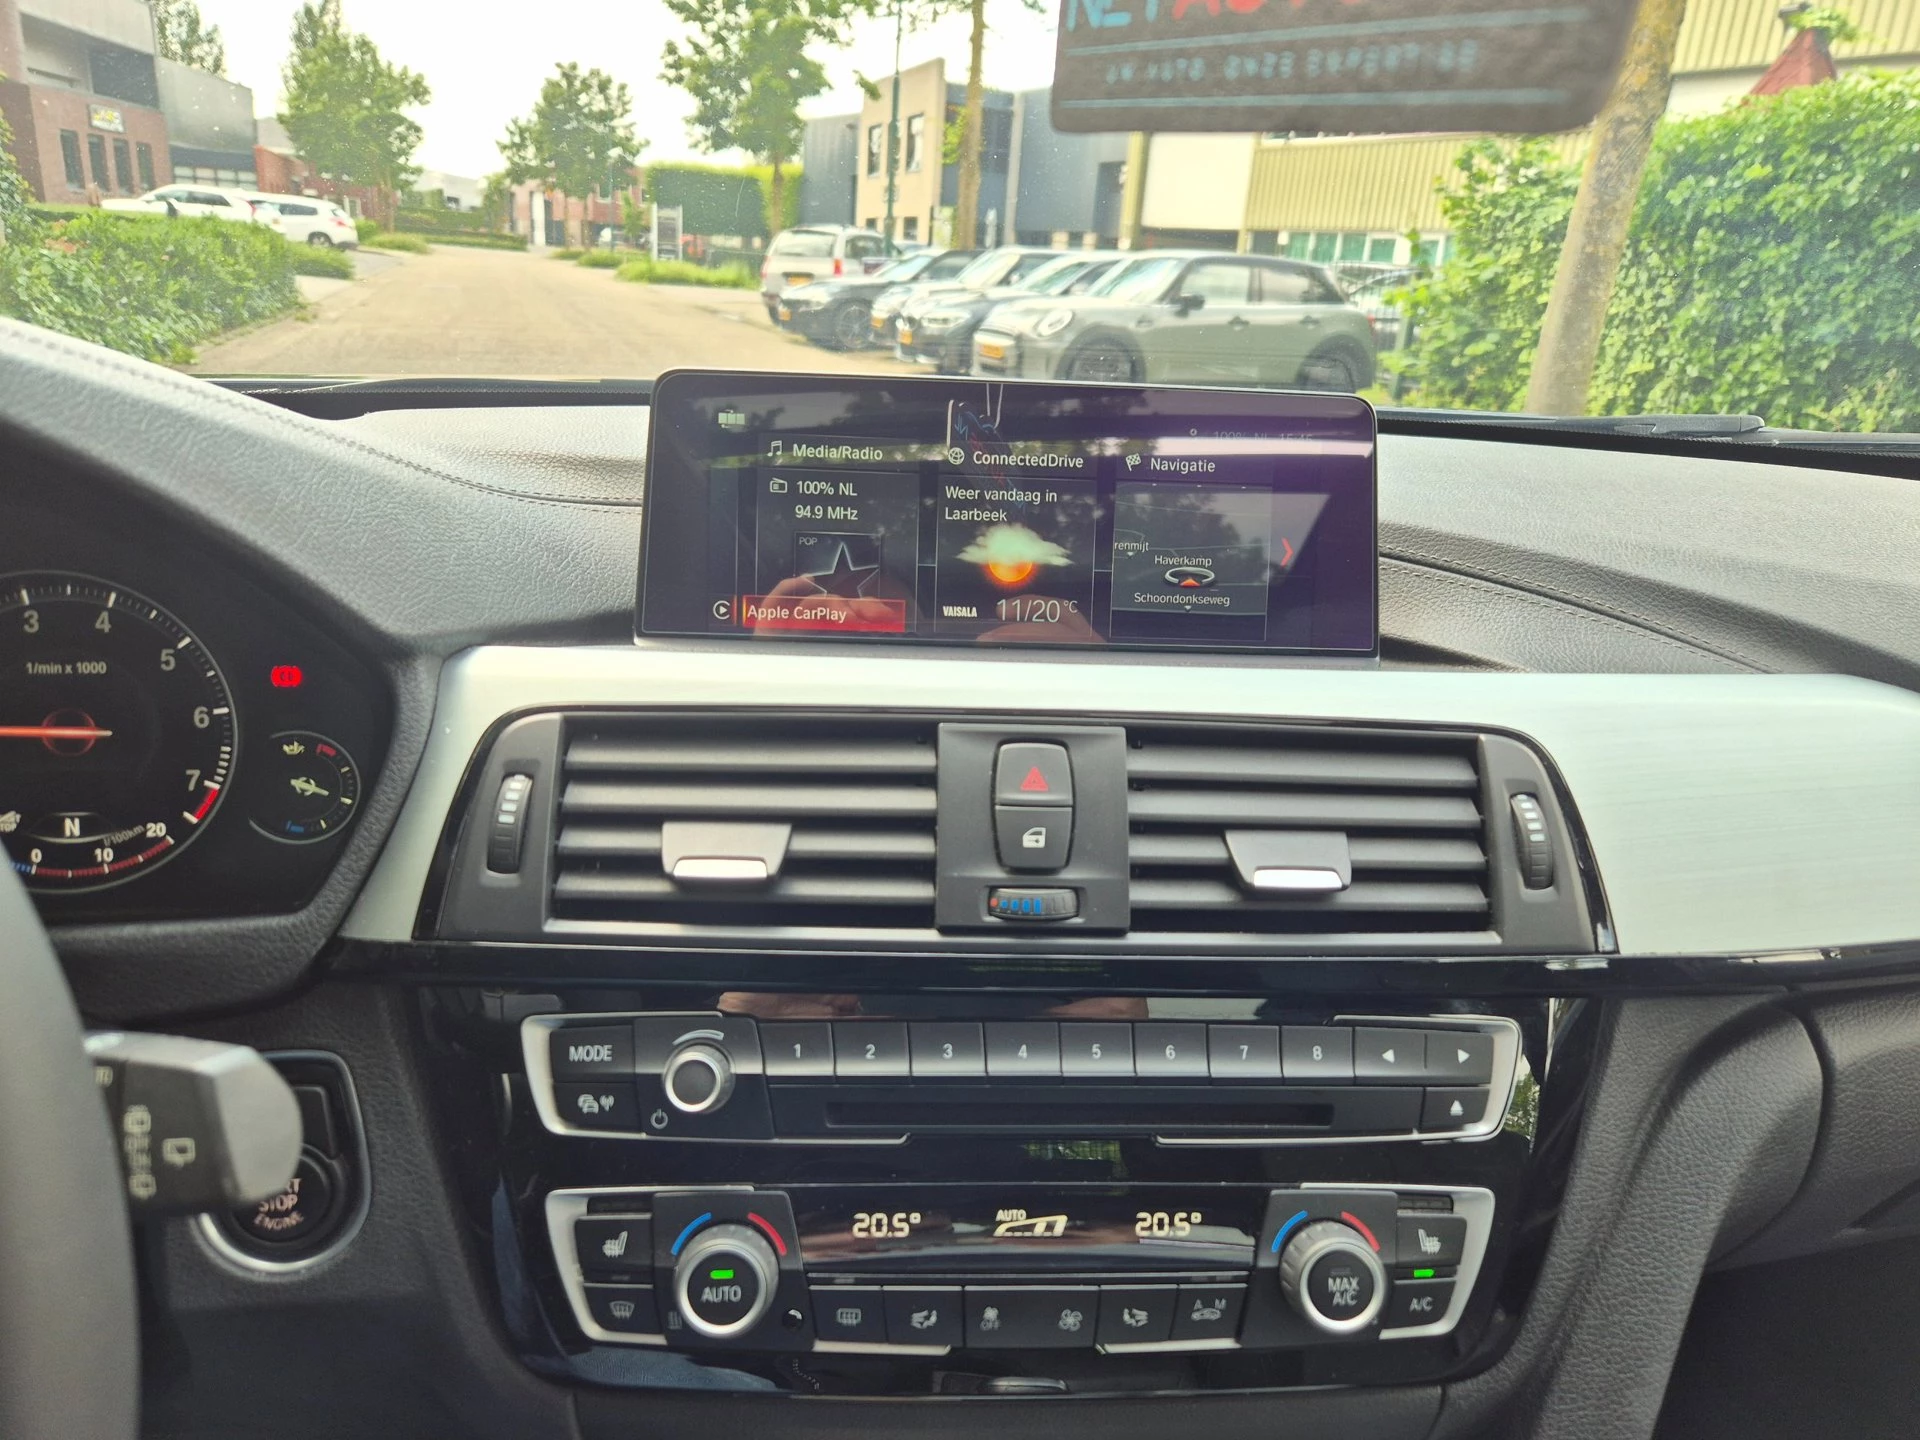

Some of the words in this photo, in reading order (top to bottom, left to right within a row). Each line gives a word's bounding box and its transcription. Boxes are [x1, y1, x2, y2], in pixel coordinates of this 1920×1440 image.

[792, 443, 884, 462] Media/Radio
[973, 450, 1084, 468] ConnectedDrive
[1150, 457, 1216, 474] Navigatie
[796, 480, 834, 496] 100%
[839, 482, 858, 497] NL
[945, 485, 981, 500] Weer
[984, 488, 1041, 504] vandaag
[1045, 489, 1058, 502] in
[795, 505, 823, 519] 94.9
[827, 506, 859, 521] MHz
[945, 507, 1008, 522] Laarbeek
[799, 537, 818, 546] POP
[1114, 539, 1150, 553] renmijt
[1154, 554, 1213, 568] Haverkamp
[1133, 592, 1231, 607] Schoondonkseweg
[747, 605, 790, 622] Apple
[793, 606, 847, 624] CarPlay
[942, 606, 978, 618] VAISALA
[996, 598, 1061, 623] 11/20
[24, 611, 40, 633] 3
[95, 611, 112, 633] 4
[26, 661, 61, 675] 1/min
[76, 661, 107, 675] 1000
[160, 648, 176, 672] 5
[193, 706, 210, 729] 6
[185, 770, 201, 792] 7
[64, 817, 81, 838] N
[145, 821, 167, 838] 20
[31, 848, 42, 863] 0
[94, 847, 114, 863] 10
[569, 1045, 613, 1062] MODE
[793, 1044, 801, 1058] 1
[865, 1044, 875, 1059] 2
[943, 1044, 953, 1059] 3
[1017, 1044, 1028, 1060] 4
[1091, 1044, 1101, 1060] 5
[1165, 1044, 1176, 1060] 6
[1239, 1045, 1249, 1061] 7
[1312, 1045, 1323, 1061] 8
[995, 1209, 1027, 1221] AUTO
[1328, 1277, 1360, 1294] MAX
[701, 1285, 742, 1303] AUTO
[1332, 1291, 1358, 1307] A/C
[1409, 1296, 1434, 1313] A/C
